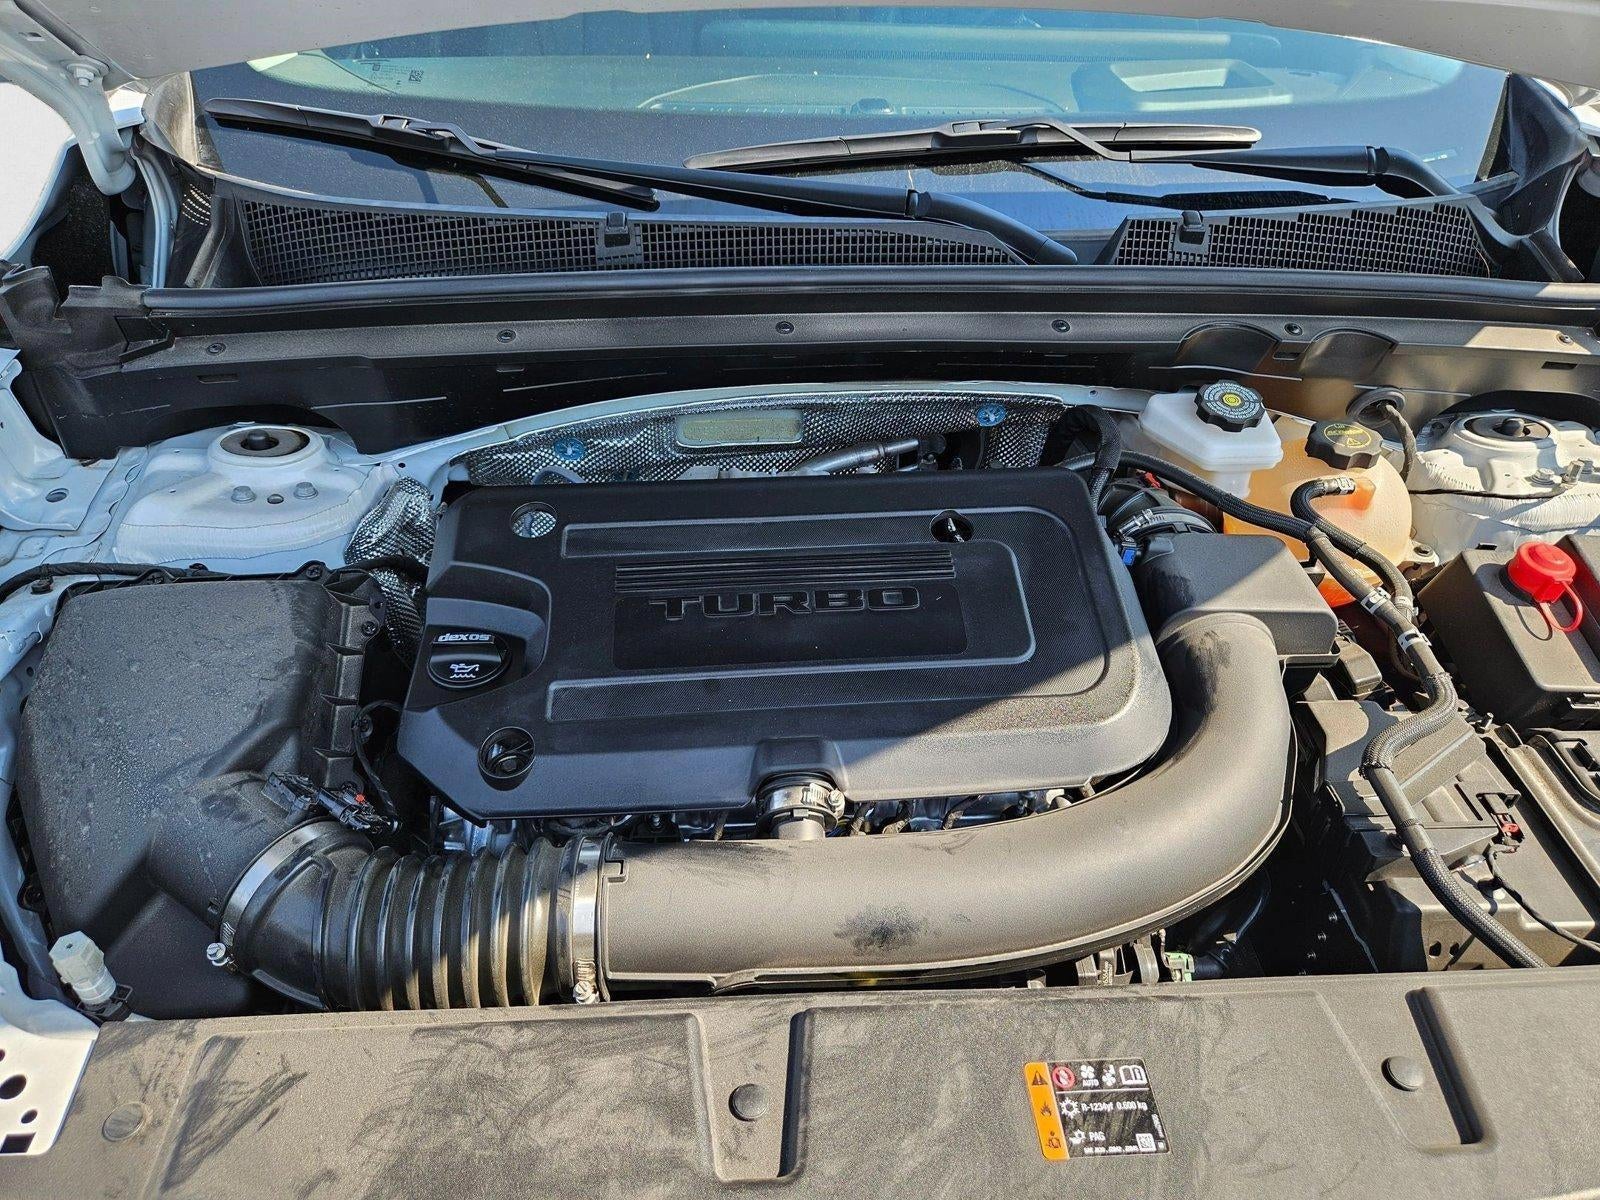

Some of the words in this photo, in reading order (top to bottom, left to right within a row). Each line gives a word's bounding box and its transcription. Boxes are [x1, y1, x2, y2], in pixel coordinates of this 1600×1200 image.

[648, 587, 921, 621] TURBO
[437, 632, 492, 642] dexos
[1082, 1079, 1099, 1087] AUTO
[1081, 1102, 1114, 1112] R-1234yf
[1137, 1101, 1148, 1111] kg
[1088, 1131, 1106, 1141] PAG
